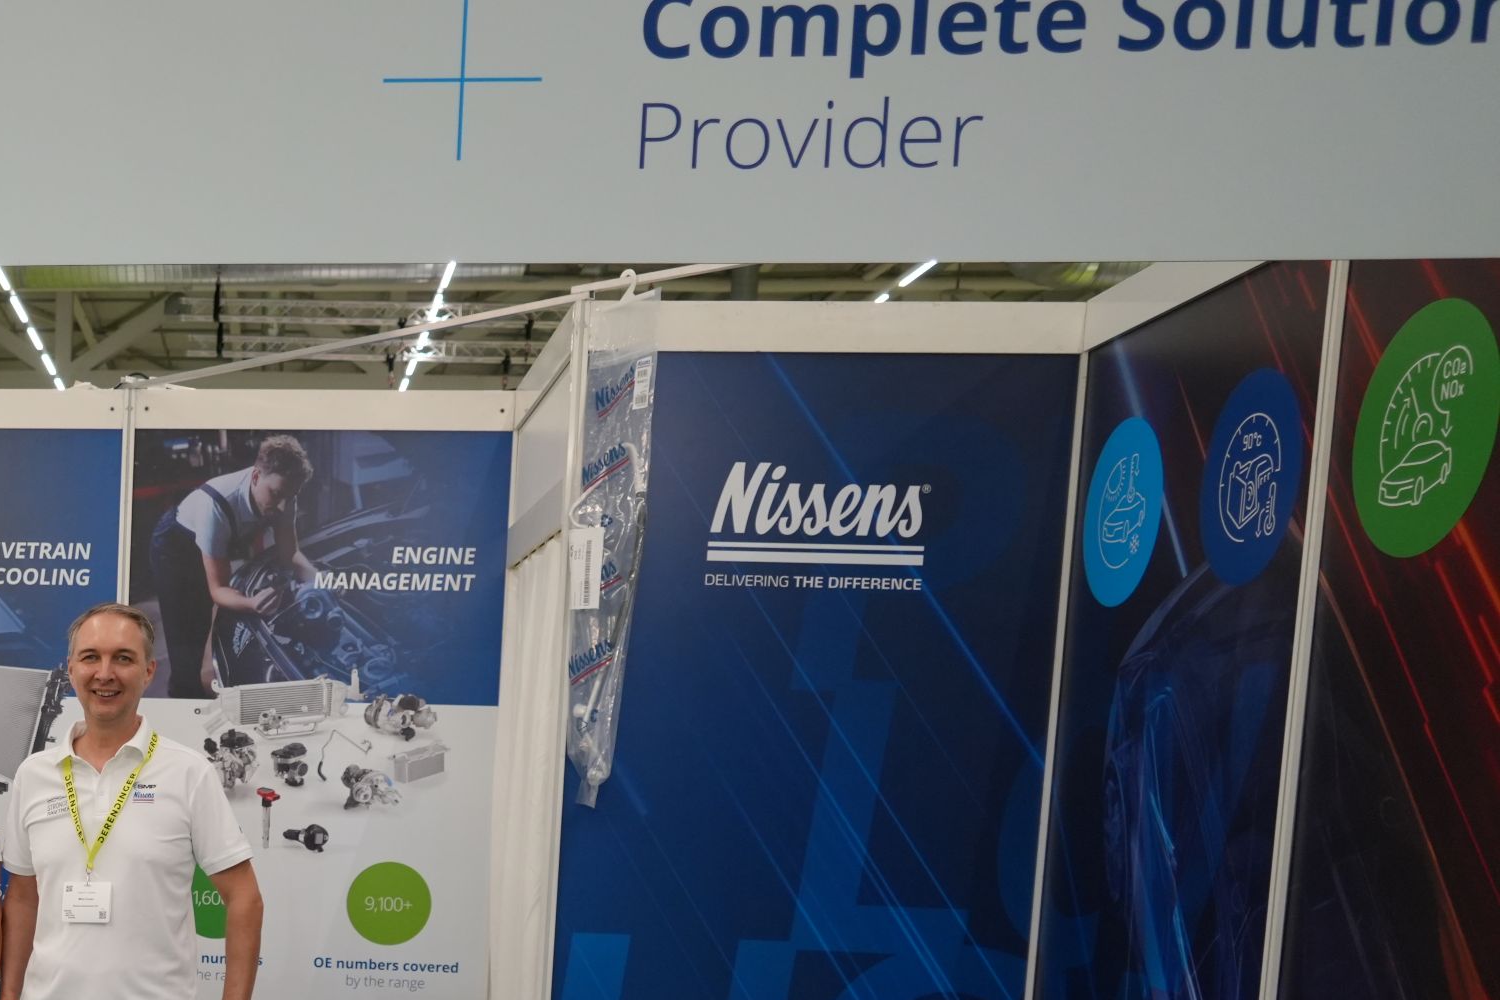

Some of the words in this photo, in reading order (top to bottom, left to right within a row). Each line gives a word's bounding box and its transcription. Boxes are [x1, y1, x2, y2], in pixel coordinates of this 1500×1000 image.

[643, 0, 1087, 79] Complete
[637, 97, 984, 170] Provider
[582, 443, 627, 486] Nissens
[391, 547, 476, 566] ENGINE
[313, 572, 476, 592] MANAGEMENT
[705, 573, 789, 588] DELIVERING
[794, 576, 823, 588] THE
[828, 577, 922, 591] DIFFERENCE
[97, 772, 137, 845] DERENDINGER
[364, 897, 412, 914] 9,100+
[313, 957, 332, 969] OE
[336, 958, 399, 972] numbers
[403, 961, 459, 974] covered
[345, 974, 361, 989] by
[364, 975, 385, 988] the
[388, 978, 426, 992] range
